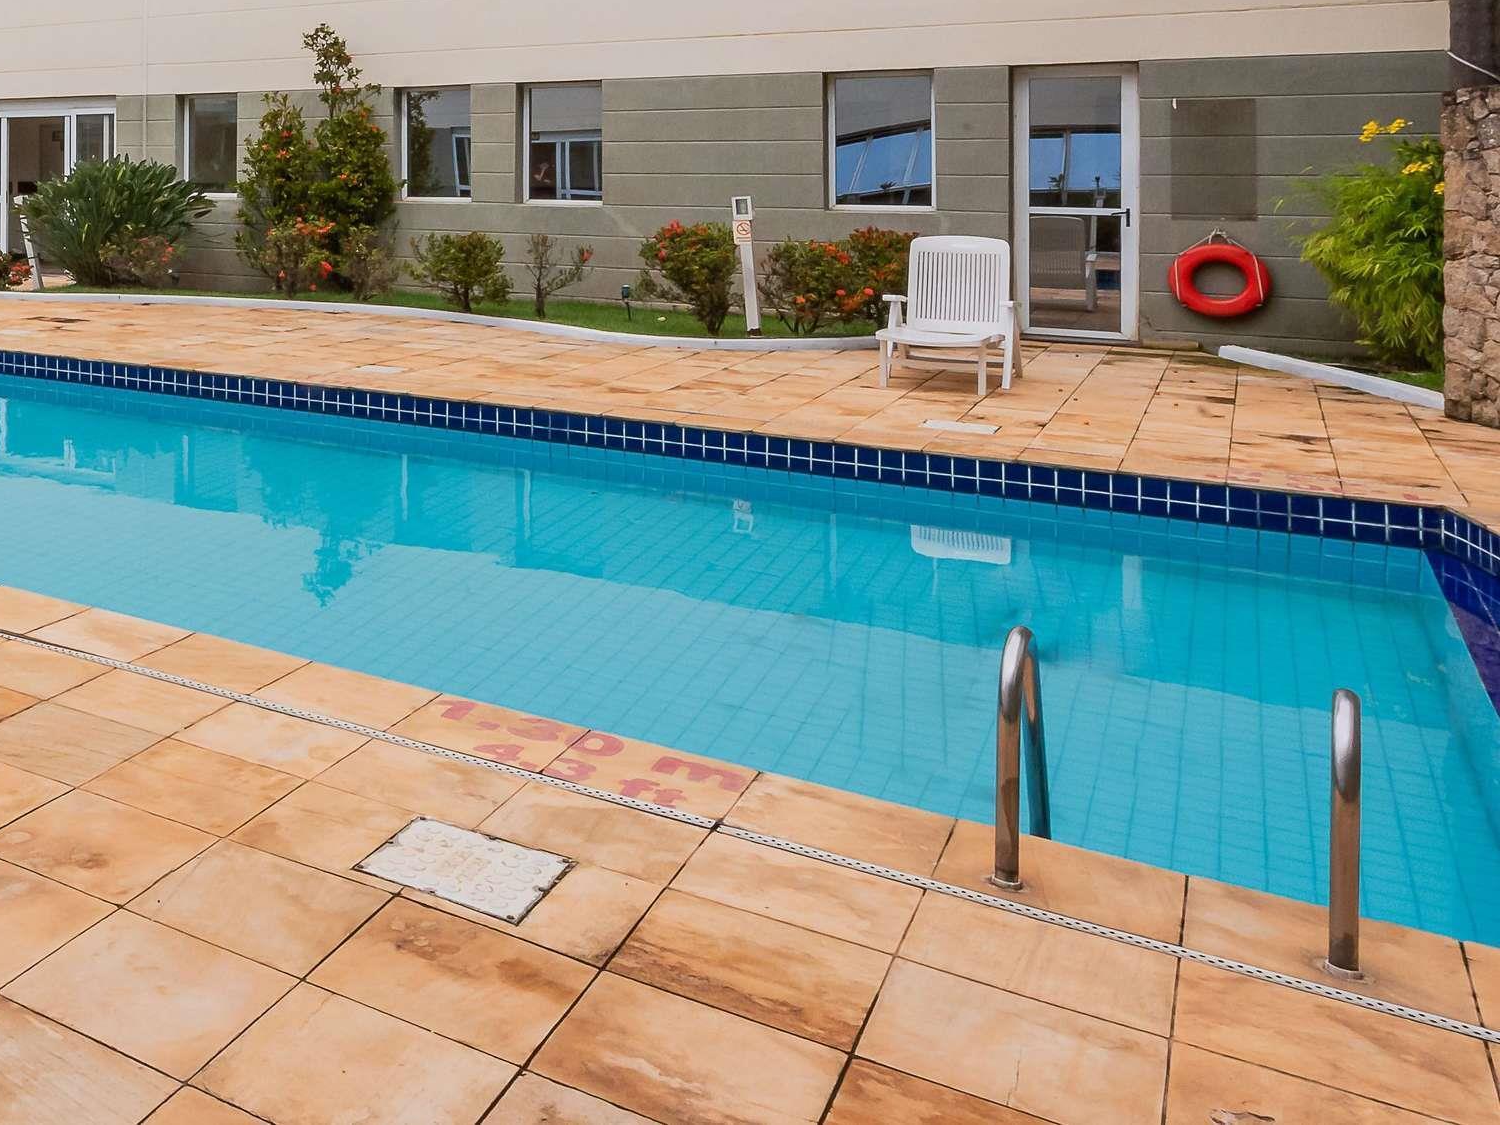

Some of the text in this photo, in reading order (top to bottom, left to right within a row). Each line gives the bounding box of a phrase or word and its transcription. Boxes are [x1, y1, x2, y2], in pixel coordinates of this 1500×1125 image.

[436, 699, 747, 793] 1.30 m
[618, 778, 686, 809] ft
